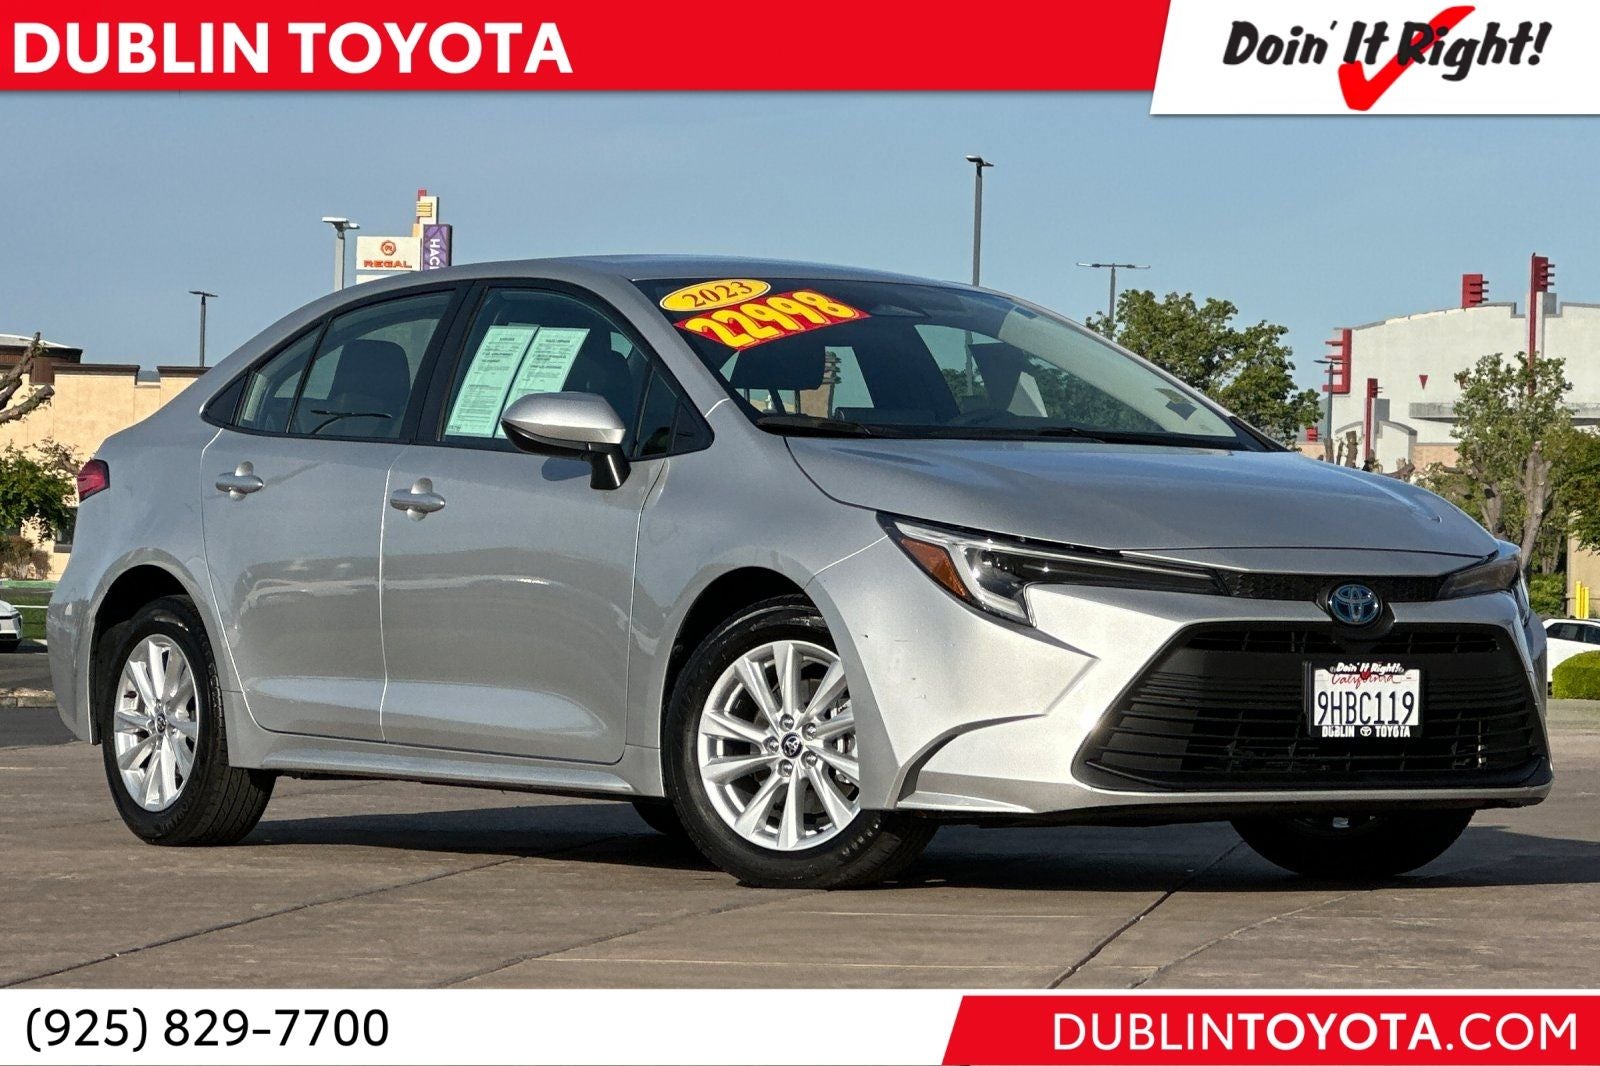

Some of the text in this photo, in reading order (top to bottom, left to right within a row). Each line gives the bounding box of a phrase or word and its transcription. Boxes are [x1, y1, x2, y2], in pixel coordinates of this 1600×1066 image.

[363, 260, 413, 269] REGAL
[429, 238, 441, 270] HAC
[682, 281, 754, 307] 2023
[685, 291, 859, 349] 22998
[1359, 662, 1370, 673] It
[1370, 662, 1401, 675] Right!
[1317, 691, 1415, 725] 9HBC119
[1321, 725, 1411, 738] DUBLIN TOYOTA
